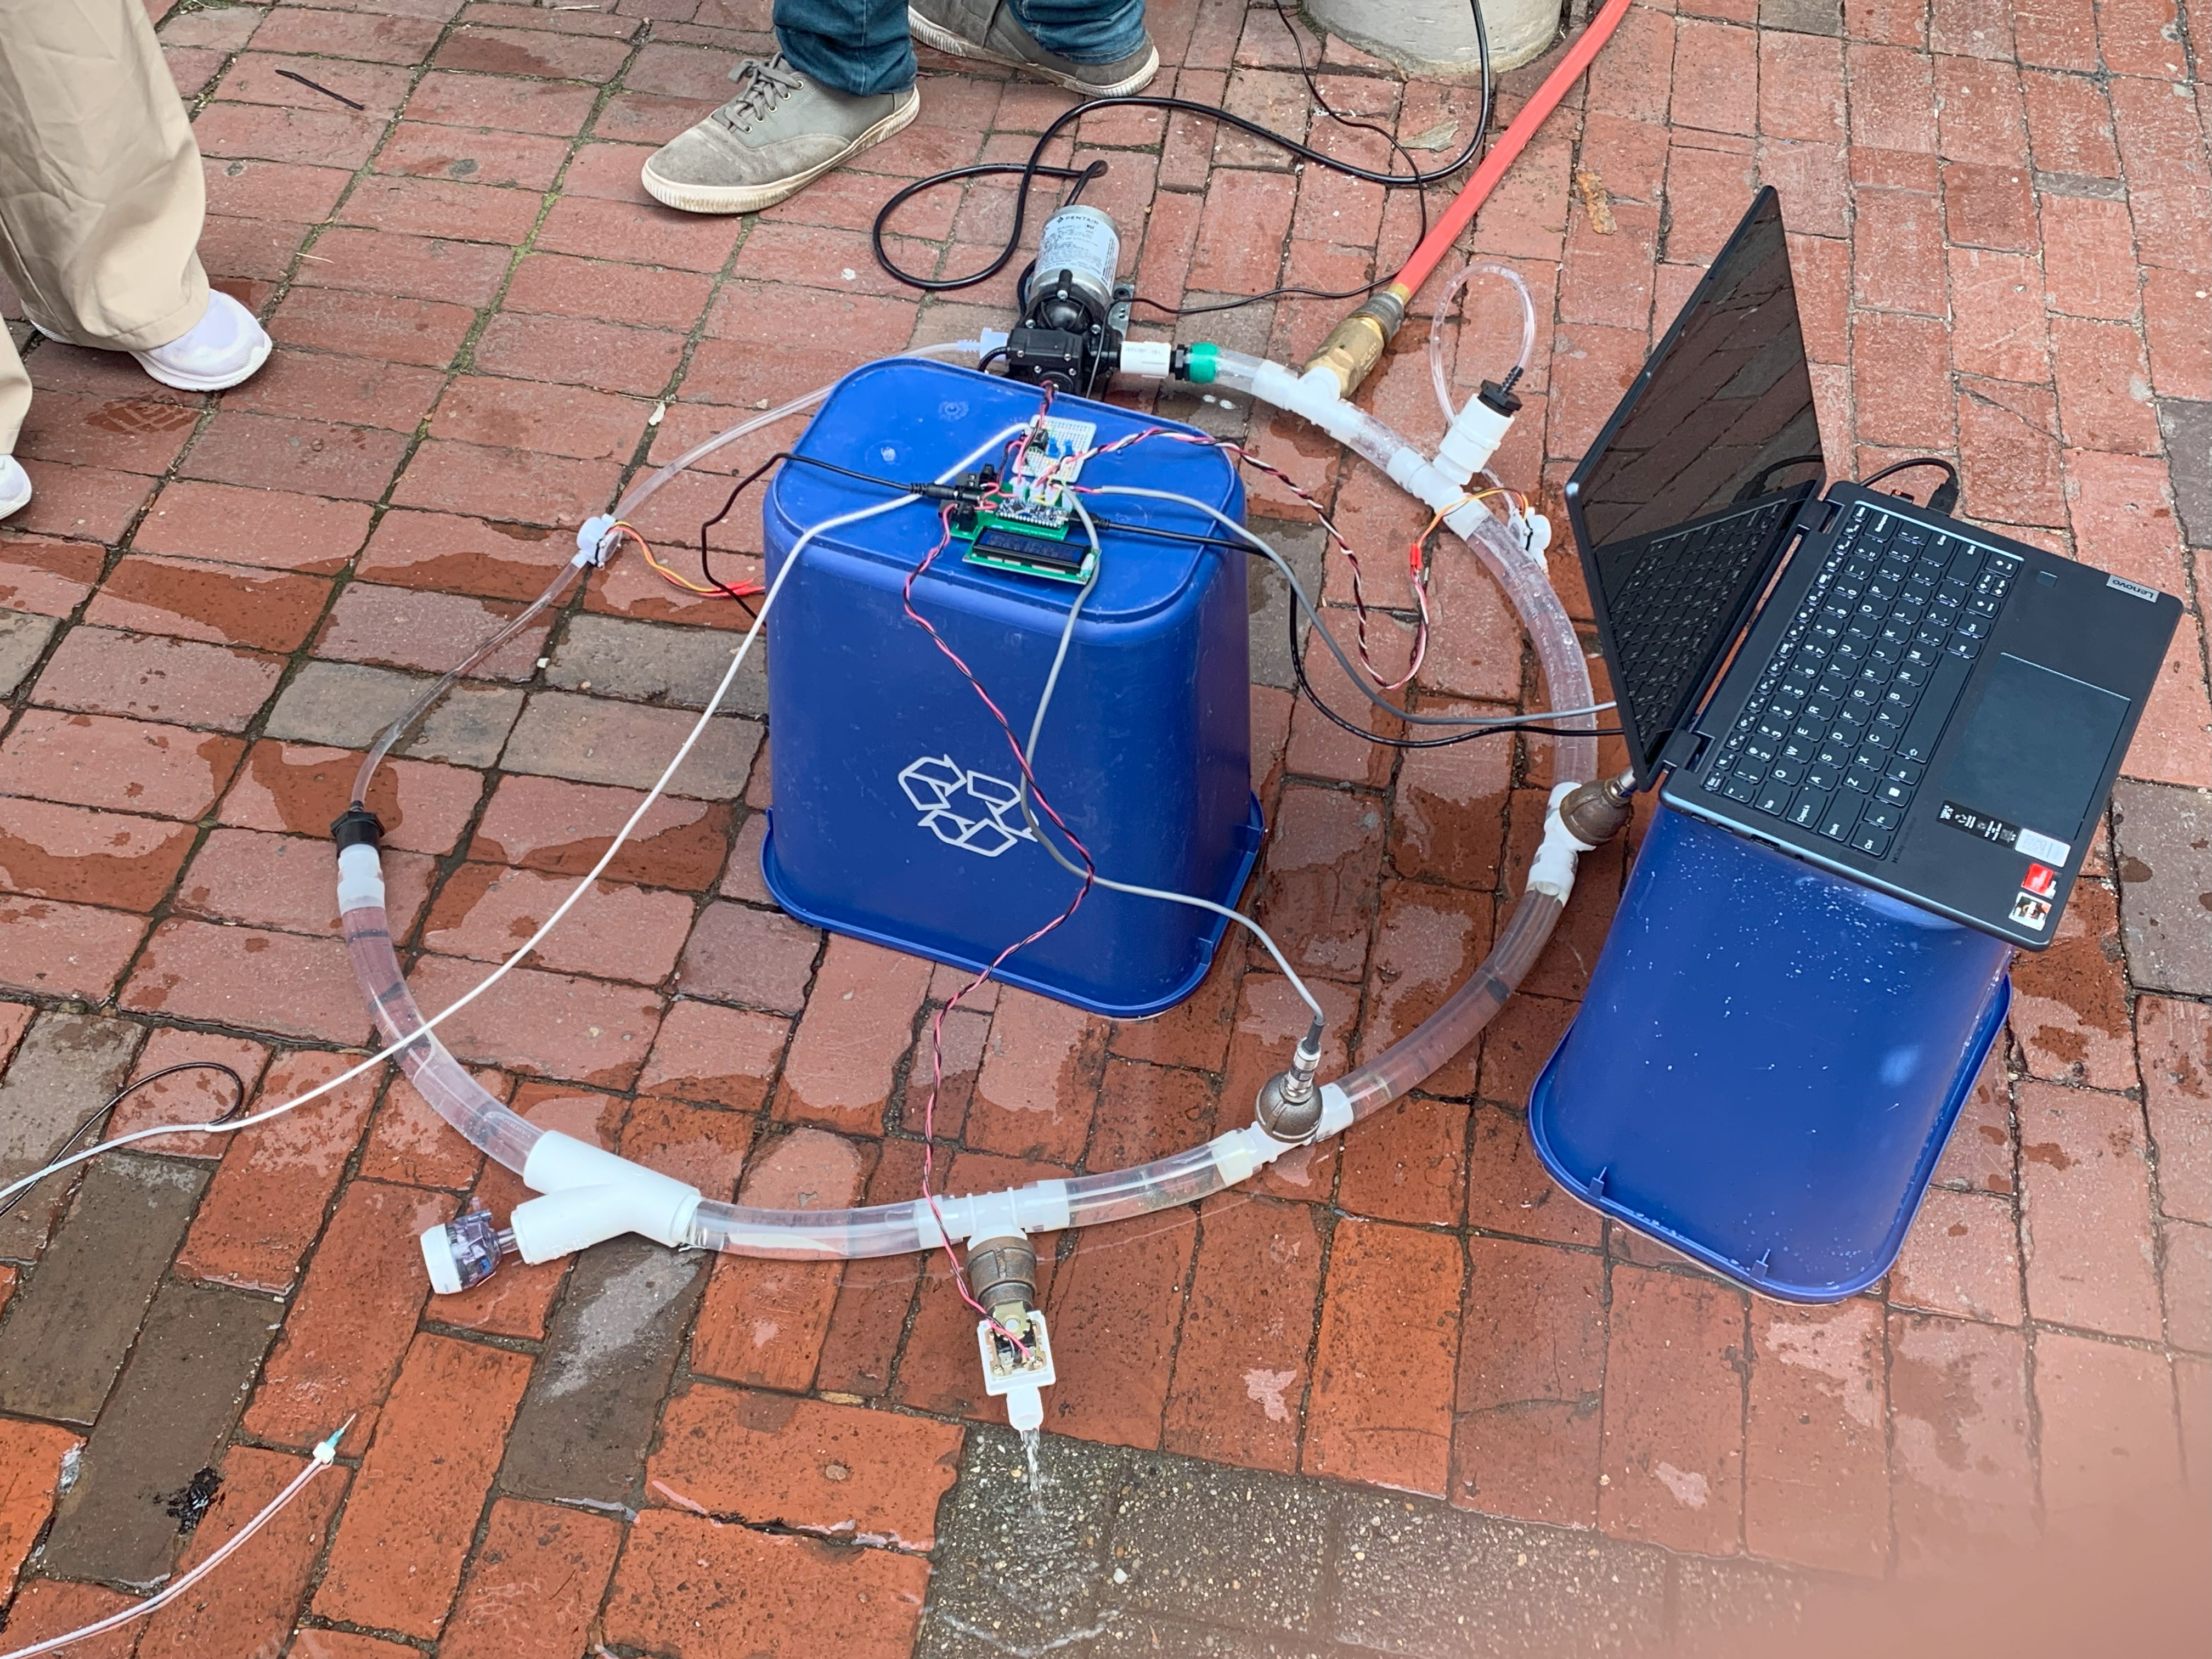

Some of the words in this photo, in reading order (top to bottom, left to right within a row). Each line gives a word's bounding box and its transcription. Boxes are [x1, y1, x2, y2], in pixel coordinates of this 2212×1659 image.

[1065, 215, 1099, 225] PENTAIR
[2113, 579, 2154, 599] Lenovo
[1786, 746, 1797, 755] W
[1847, 777, 1858, 786] Z
